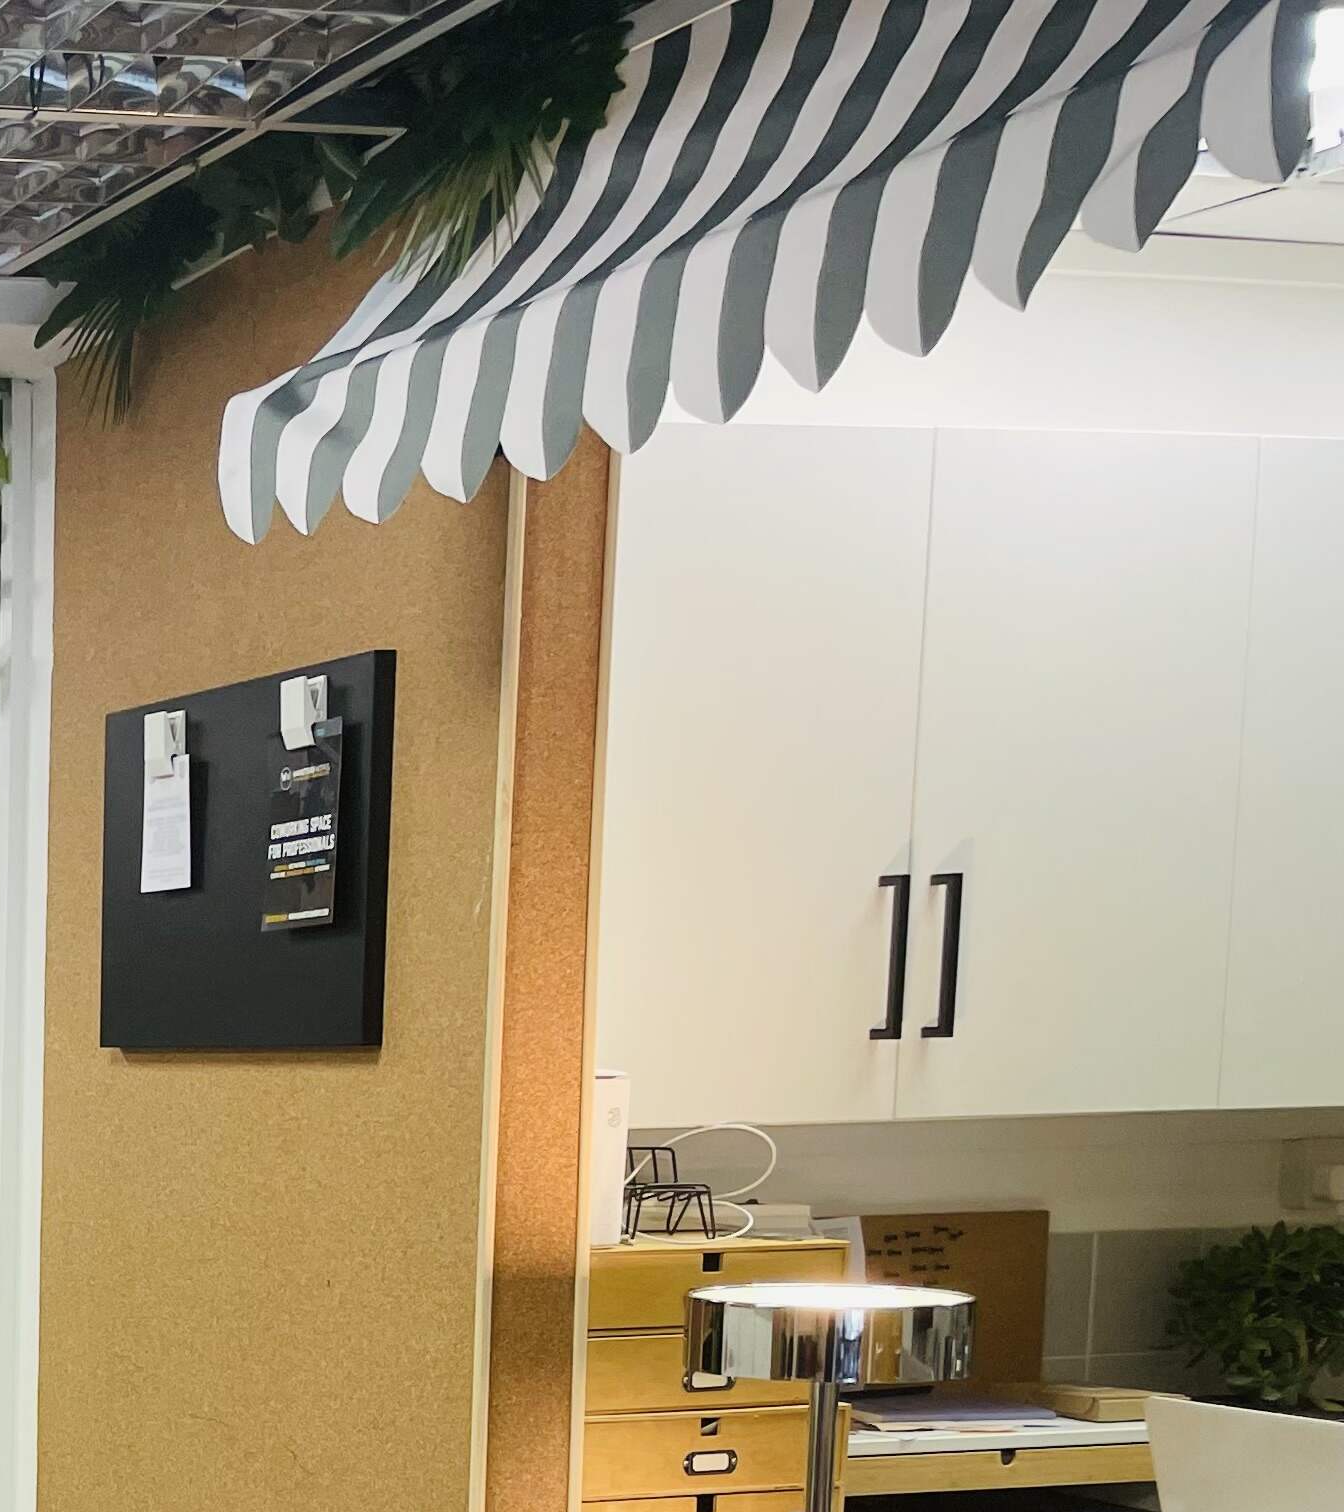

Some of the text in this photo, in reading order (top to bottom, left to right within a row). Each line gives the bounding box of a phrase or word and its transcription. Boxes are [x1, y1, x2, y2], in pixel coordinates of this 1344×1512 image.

[310, 813, 332, 833] SPACE
[267, 833, 336, 860] FOR PROFESSIONALS
